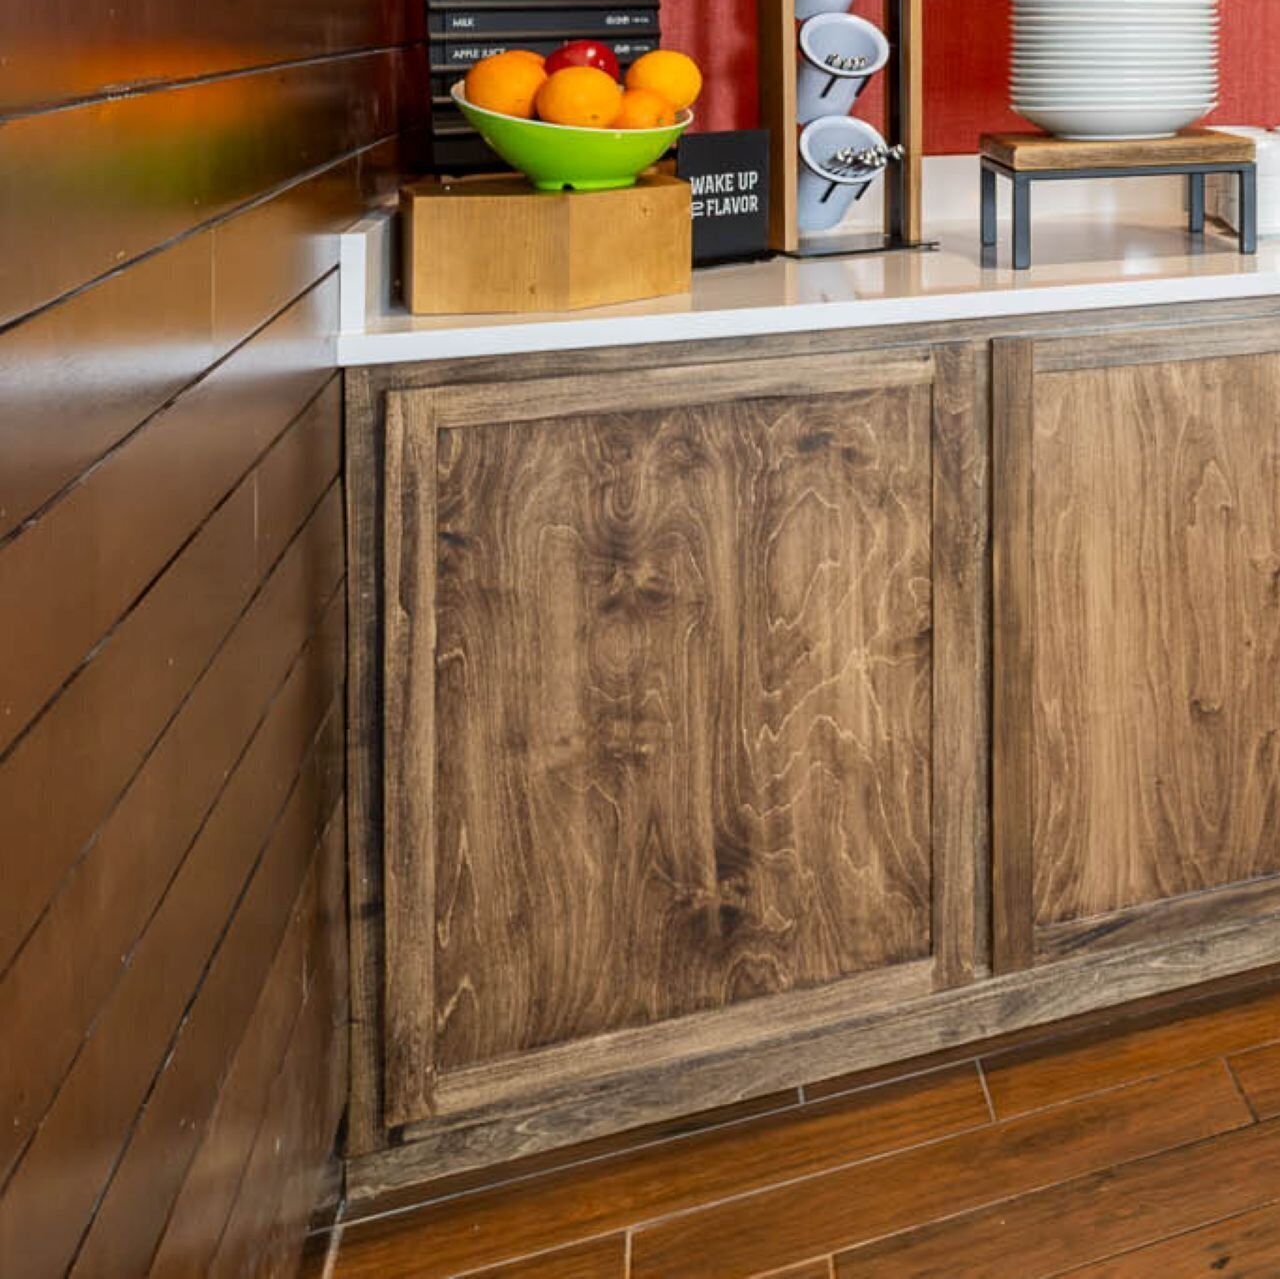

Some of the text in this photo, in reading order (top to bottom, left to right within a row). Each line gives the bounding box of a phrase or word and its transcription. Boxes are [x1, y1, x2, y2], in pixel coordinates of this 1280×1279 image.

[453, 18, 475, 28] MILK
[452, 48, 480, 59] APPLE
[689, 170, 759, 195] WAKE UP
[705, 194, 759, 217] FLAVOR
